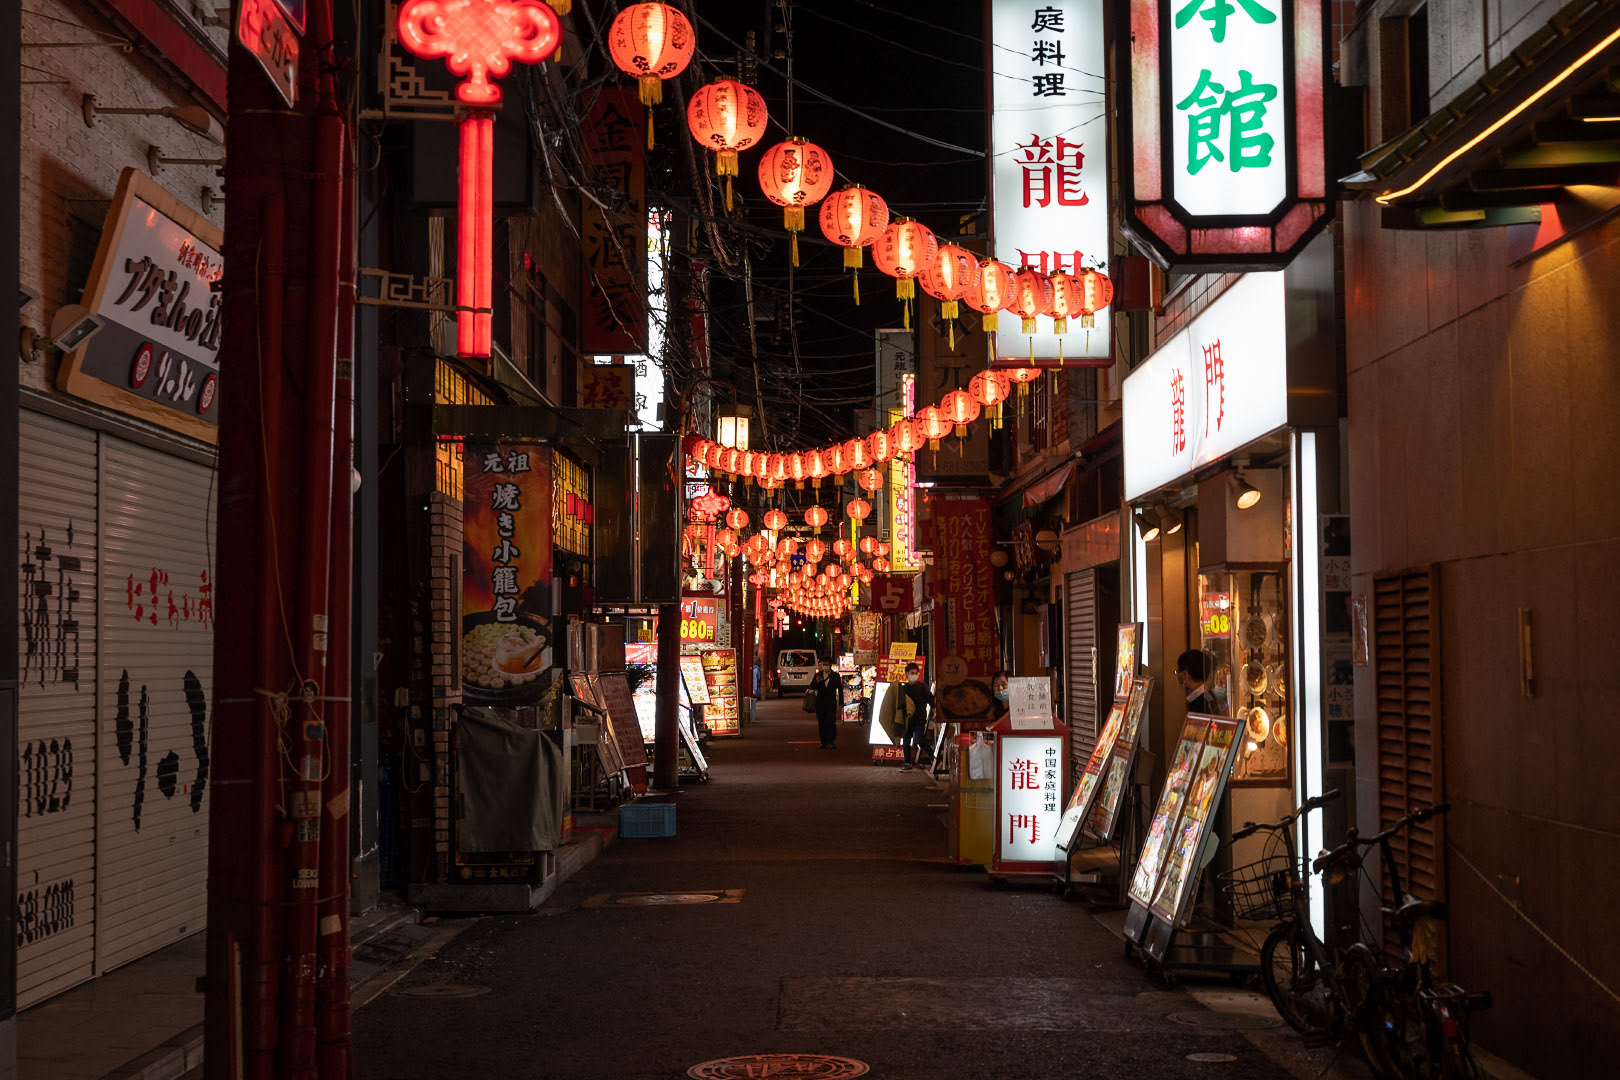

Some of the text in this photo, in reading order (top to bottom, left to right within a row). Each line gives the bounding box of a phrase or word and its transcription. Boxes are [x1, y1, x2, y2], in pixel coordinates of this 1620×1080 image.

[1031, 5, 1067, 98] 庭料理
[113, 255, 223, 362] ブタまんの江
[1170, 338, 1228, 456] 龍門
[482, 451, 531, 474] 元祖
[491, 482, 521, 623] 焼き小籠包
[880, 581, 905, 609] 占
[16, 737, 73, 819] 1029
[1008, 757, 1041, 846] 龍門
[1043, 746, 1058, 813] 中国家庭料理
